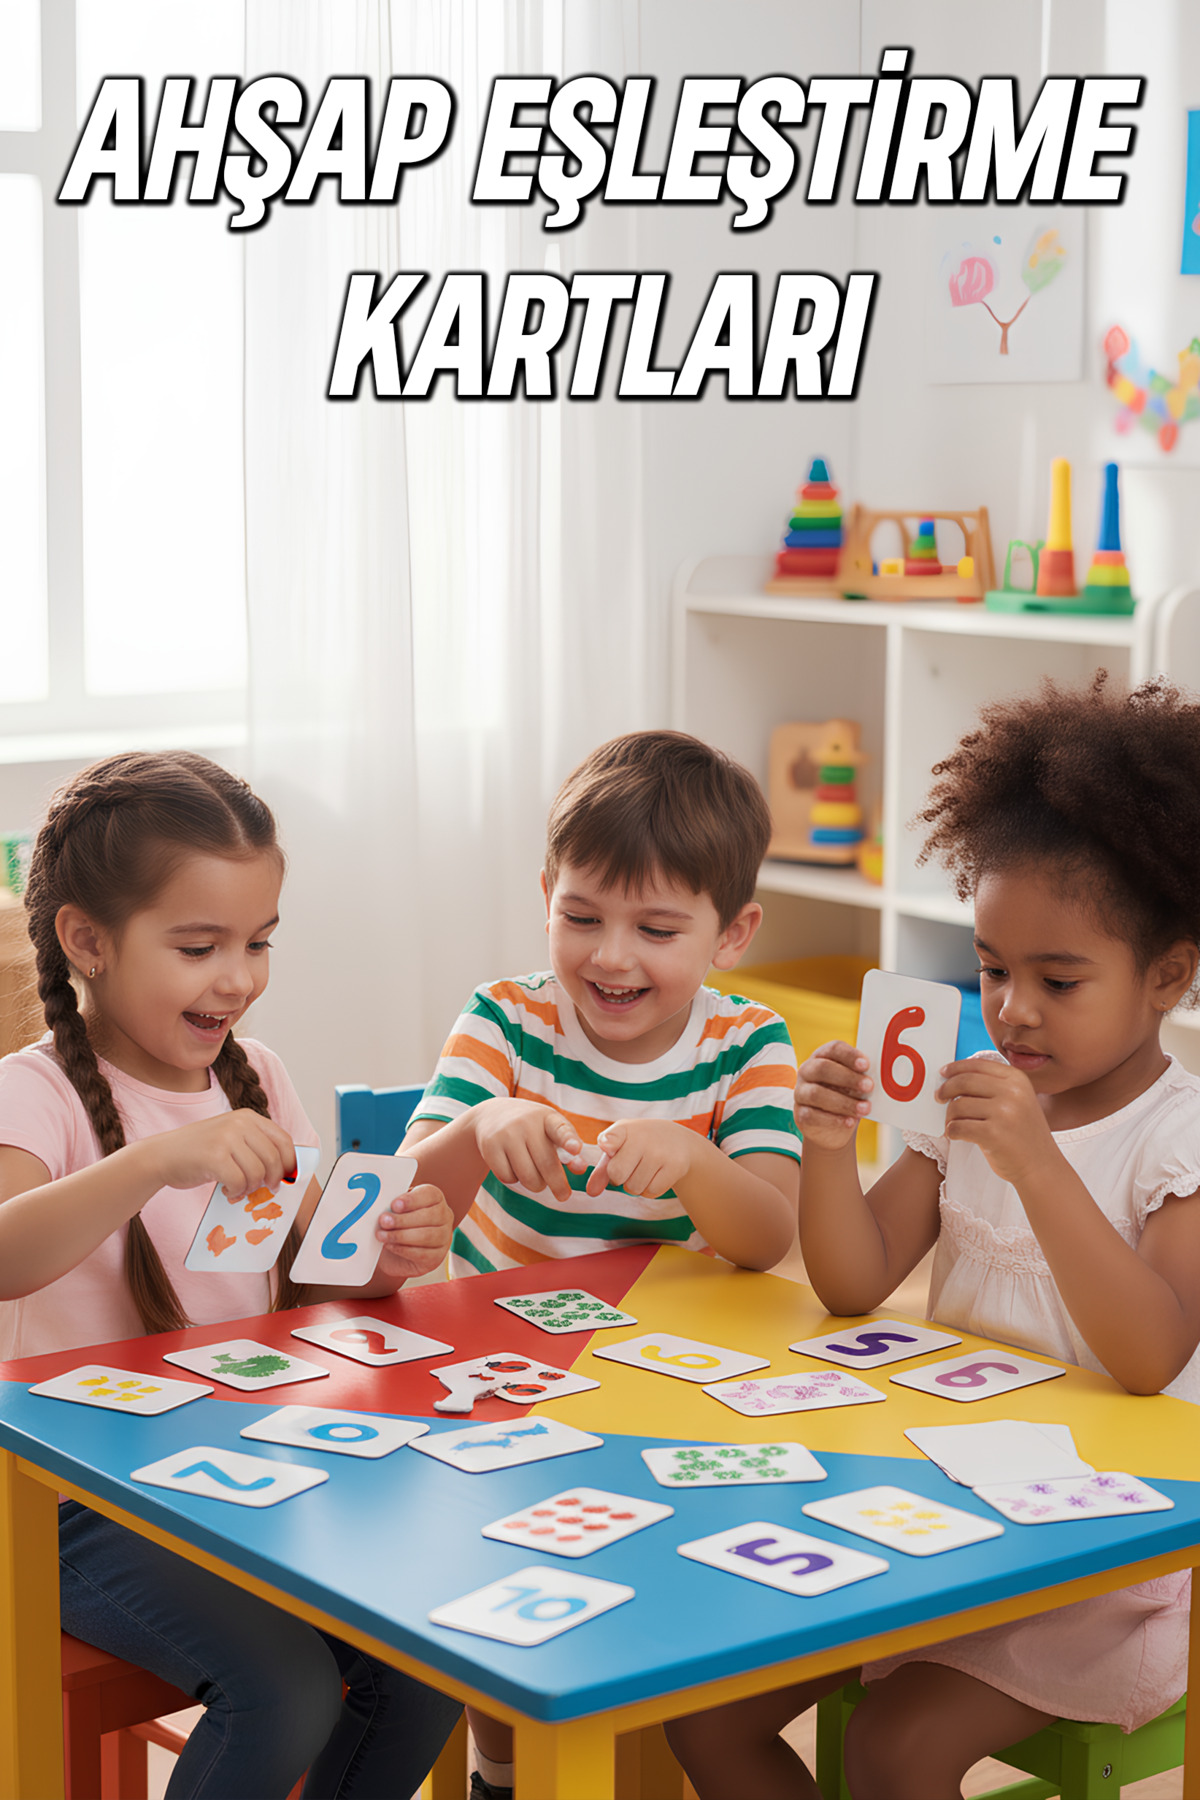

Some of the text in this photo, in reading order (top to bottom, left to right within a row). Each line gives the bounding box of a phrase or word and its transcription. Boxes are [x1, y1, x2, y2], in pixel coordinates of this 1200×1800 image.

[879, 1005, 926, 1103] 6
[320, 1172, 381, 1260] 2
[727, 1538, 834, 1576] 5
[489, 1584, 589, 1622] 10
